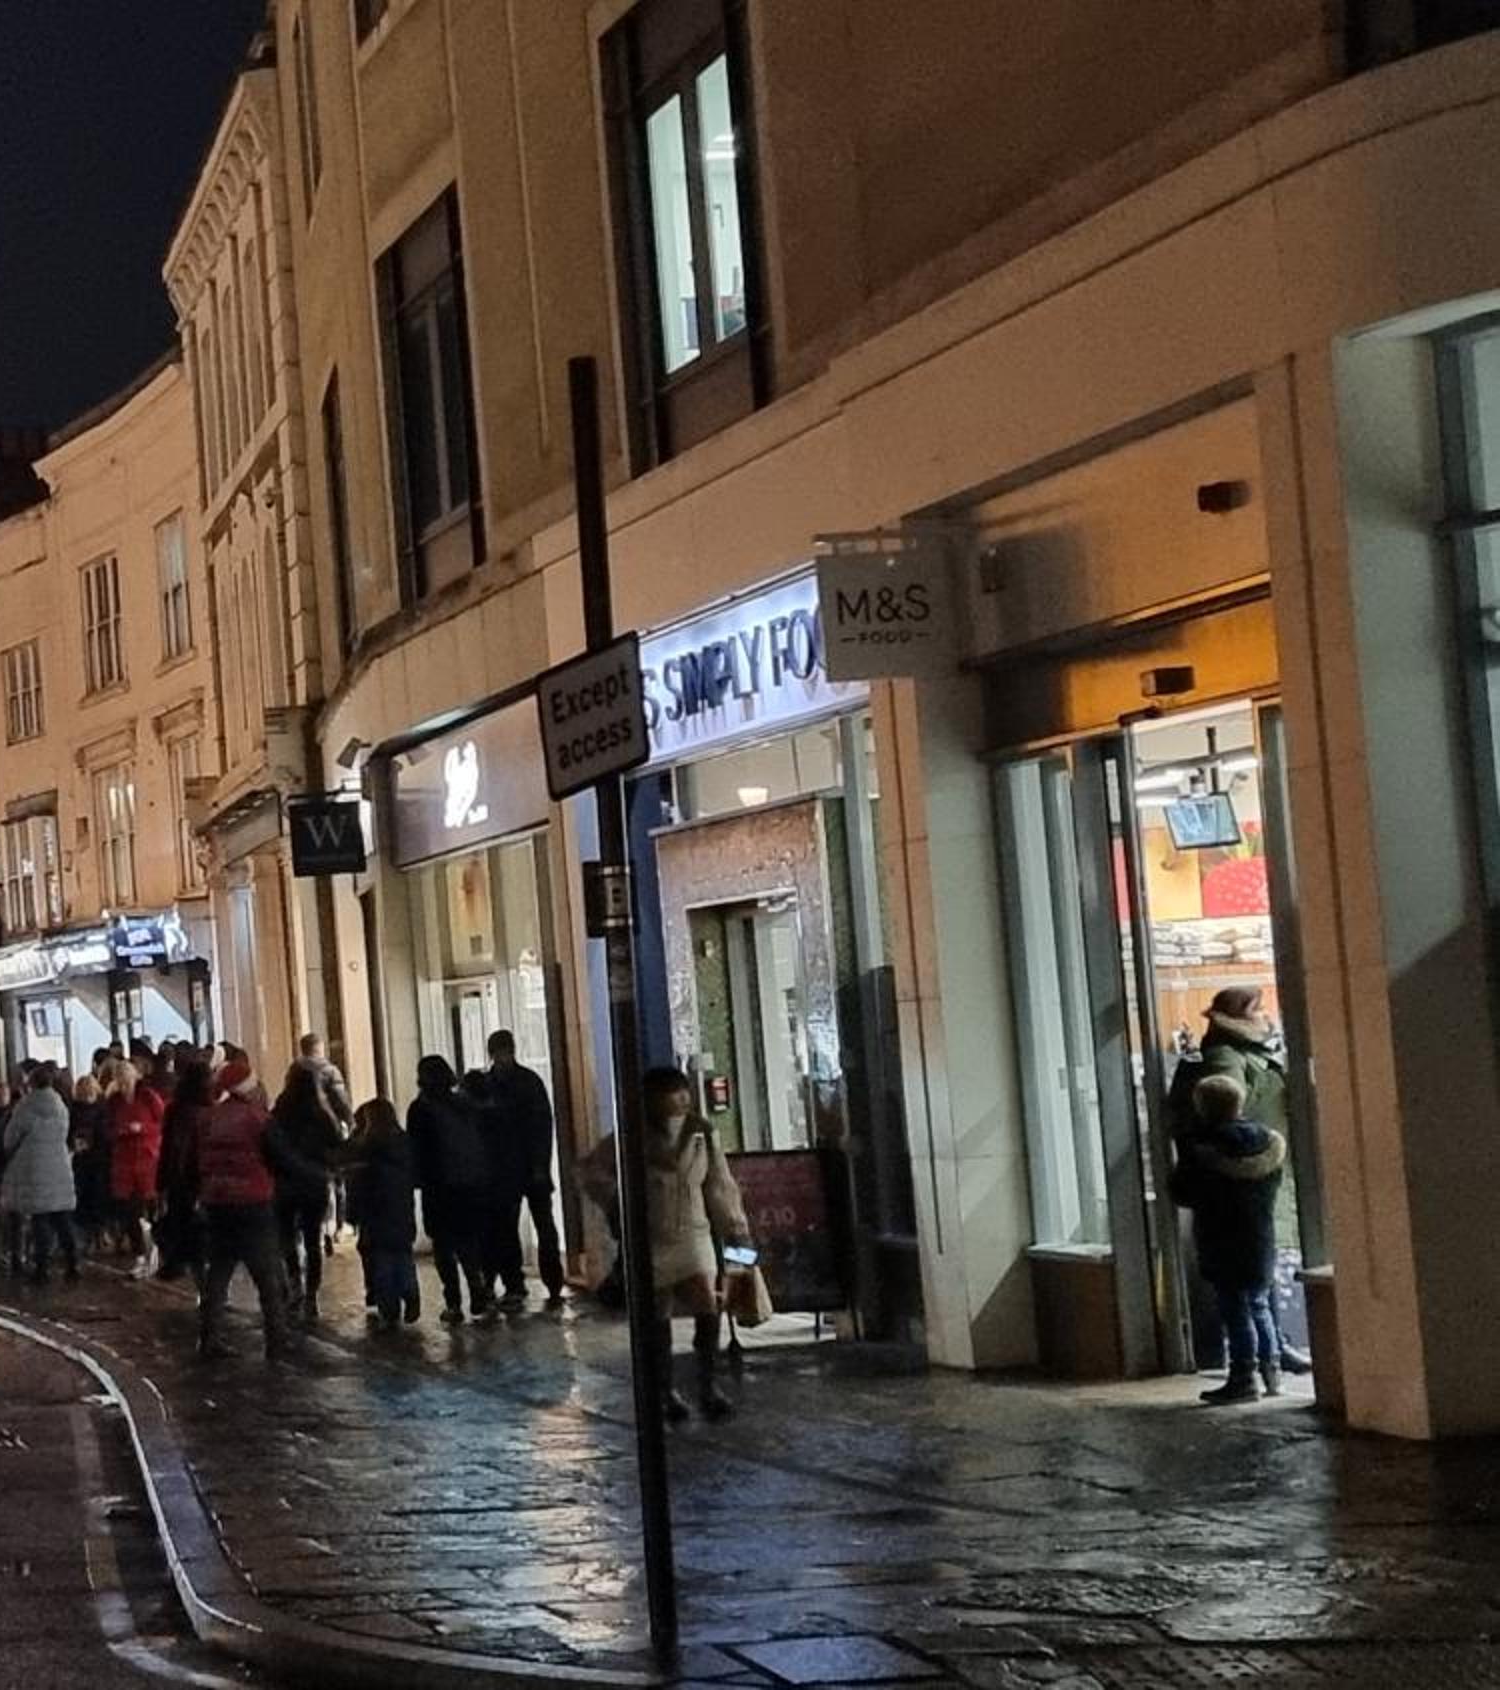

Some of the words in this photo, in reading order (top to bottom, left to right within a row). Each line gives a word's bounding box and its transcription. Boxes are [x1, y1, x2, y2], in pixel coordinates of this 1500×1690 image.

[836, 583, 931, 626] M&S
[857, 630, 911, 645] FOOD
[663, 625, 763, 722] SIMPLY
[769, 607, 827, 688] FO
[552, 662, 631, 724] Except
[557, 717, 632, 771] access
[303, 815, 348, 849] W
